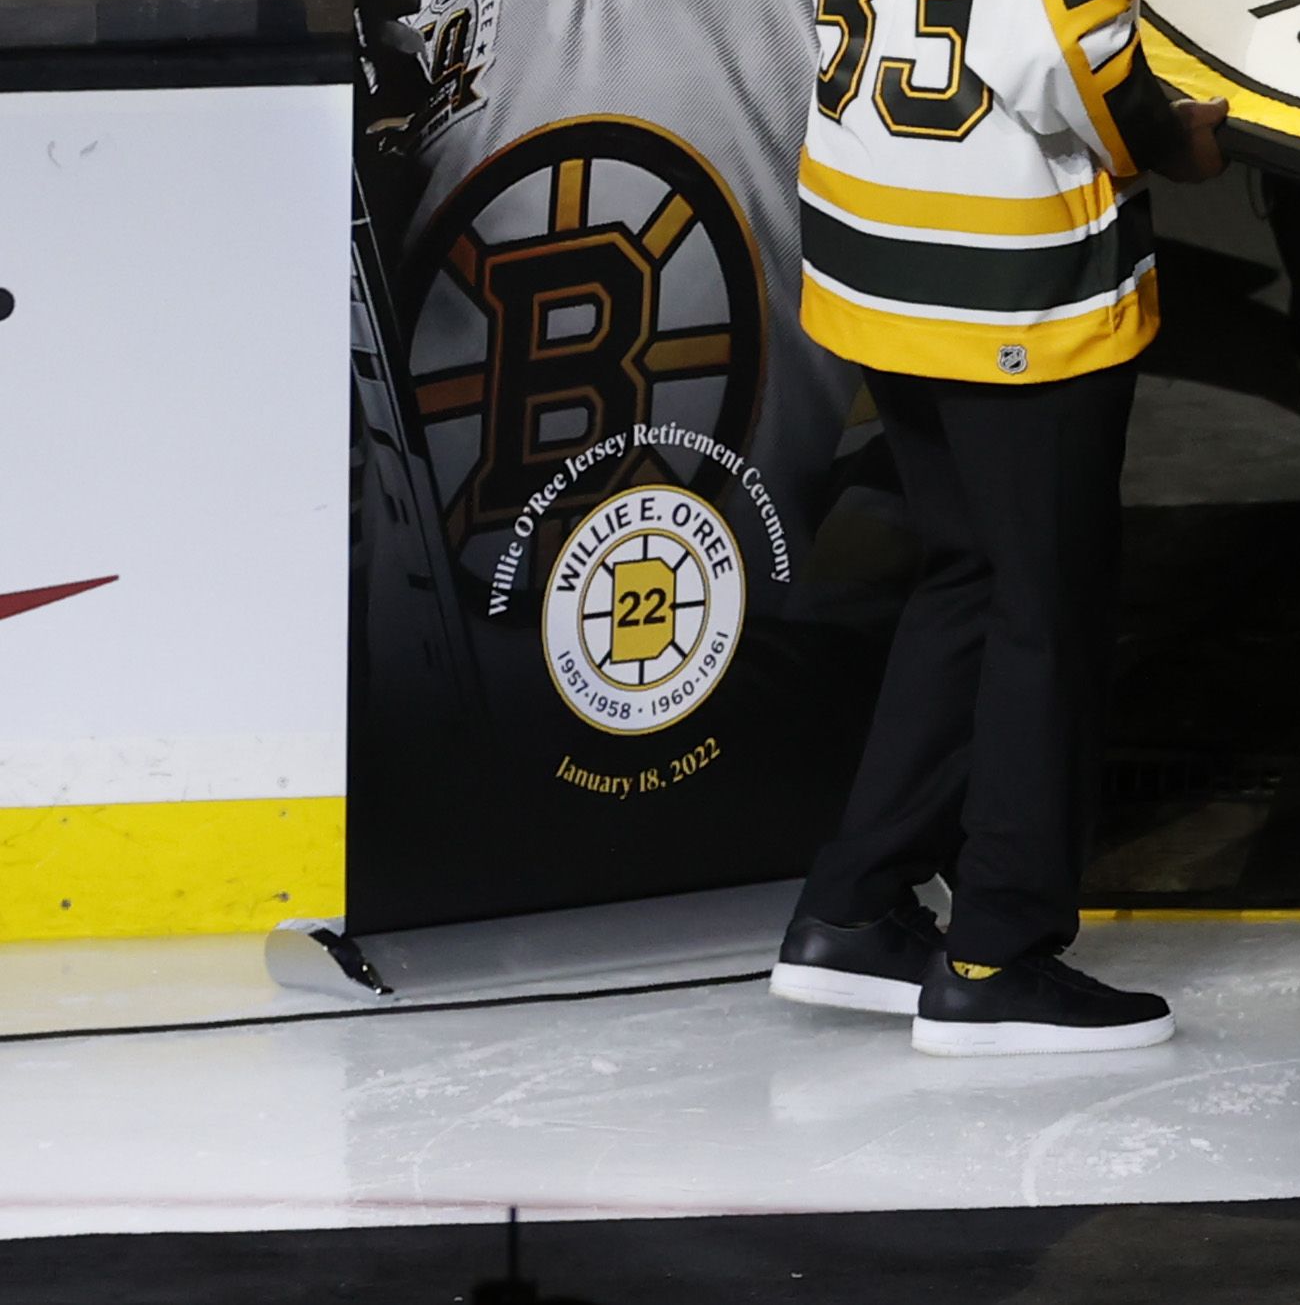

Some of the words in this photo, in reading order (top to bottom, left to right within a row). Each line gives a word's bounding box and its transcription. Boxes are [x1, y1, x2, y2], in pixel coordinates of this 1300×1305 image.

[474, 228, 656, 527] B
[488, 542, 524, 617] Willie
[514, 473, 568, 538] O'Ree
[565, 432, 628, 482] Jersey
[633, 422, 745, 476] Retirement
[742, 467, 792, 584] Ceremony
[557, 503, 632, 593] WILLIE
[640, 497, 662, 522] E.
[672, 502, 733, 580] O'REE
[618, 587, 667, 628] 22
[557, 650, 632, 720] 1957-1958
[651, 631, 729, 716] 1960-1961
[555, 755, 633, 800] January
[670, 736, 721, 783] 2022
